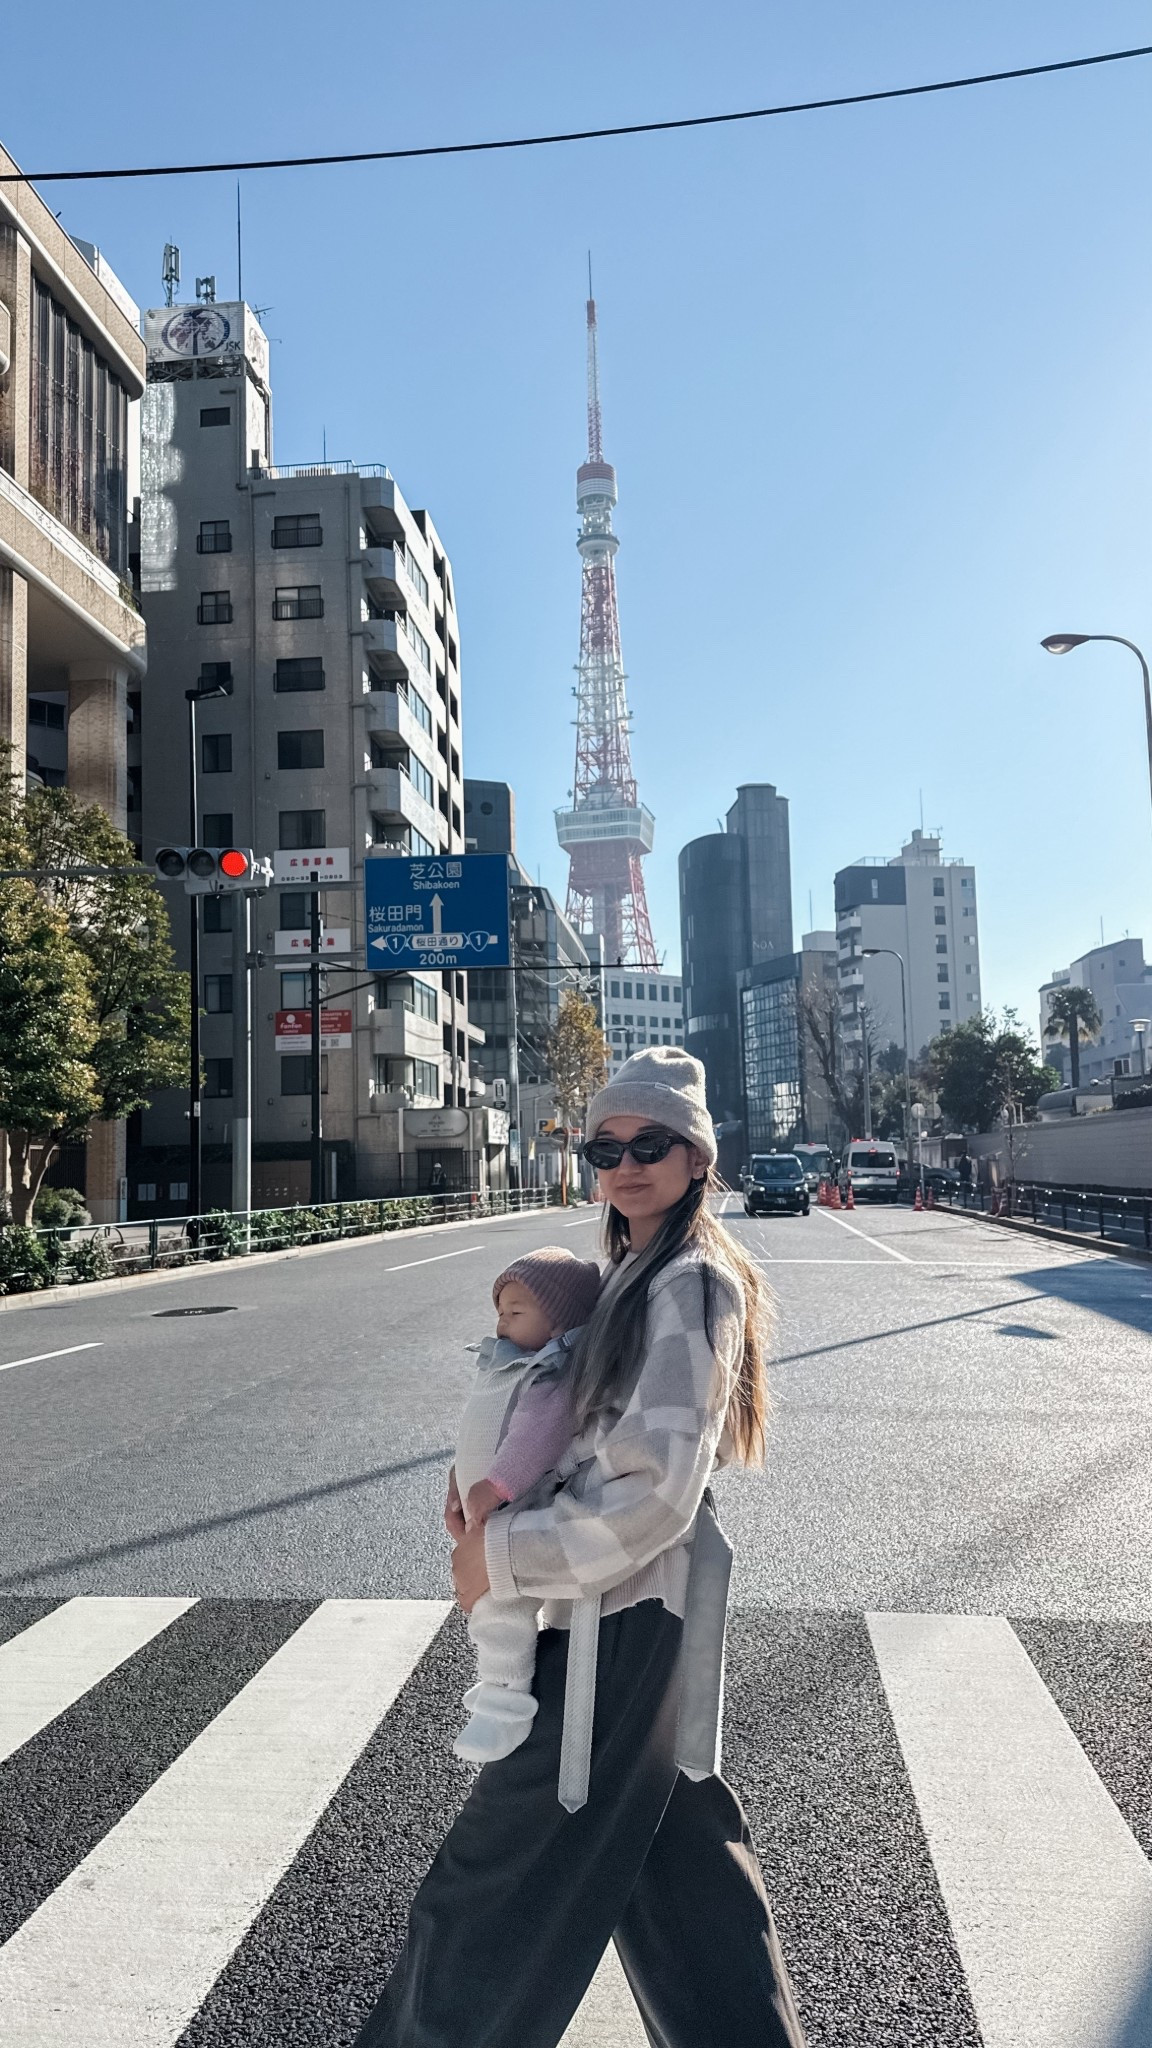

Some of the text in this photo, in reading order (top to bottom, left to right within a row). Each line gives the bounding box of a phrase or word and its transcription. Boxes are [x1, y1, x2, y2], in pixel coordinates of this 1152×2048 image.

[224, 341, 241, 351] JSK
[409, 861, 462, 880] 芝公園
[413, 880, 460, 890] Shibakoen
[369, 904, 422, 922] 桜田門
[368, 923, 424, 934] Sakuradamon
[291, 938, 335, 947] 広告集
[392, 937, 398, 949] 1
[416, 935, 459, 948] 桜田通り
[475, 934, 482, 946] 1
[752, 940, 774, 950] NOA
[419, 953, 457, 965] 200m
[539, 1120, 548, 1131] P
